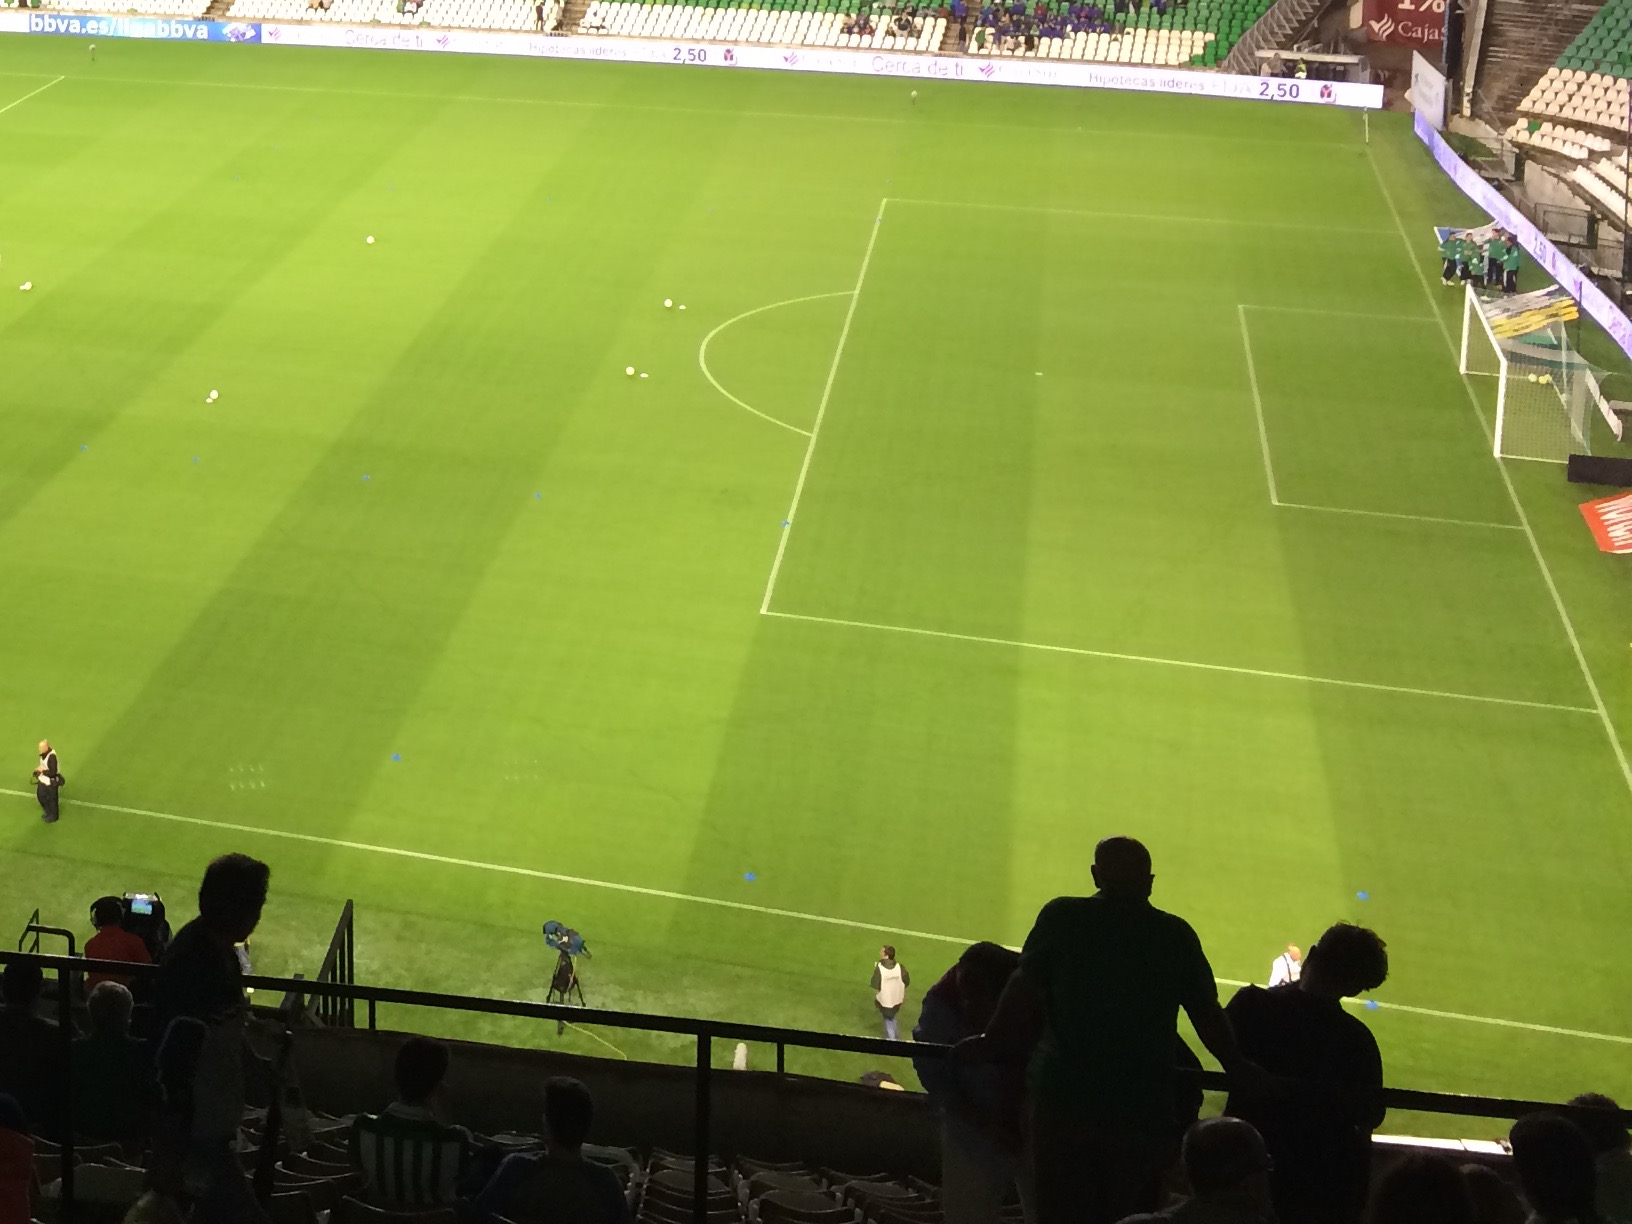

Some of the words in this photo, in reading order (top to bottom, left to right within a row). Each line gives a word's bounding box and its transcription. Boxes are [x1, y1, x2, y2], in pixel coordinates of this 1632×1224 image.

[672, 46, 708, 64] 2,50
[871, 55, 921, 75] Cerca
[927, 59, 949, 77] de
[1088, 73, 1156, 89] Hipotecas
[1258, 81, 1300, 100] 2,50
